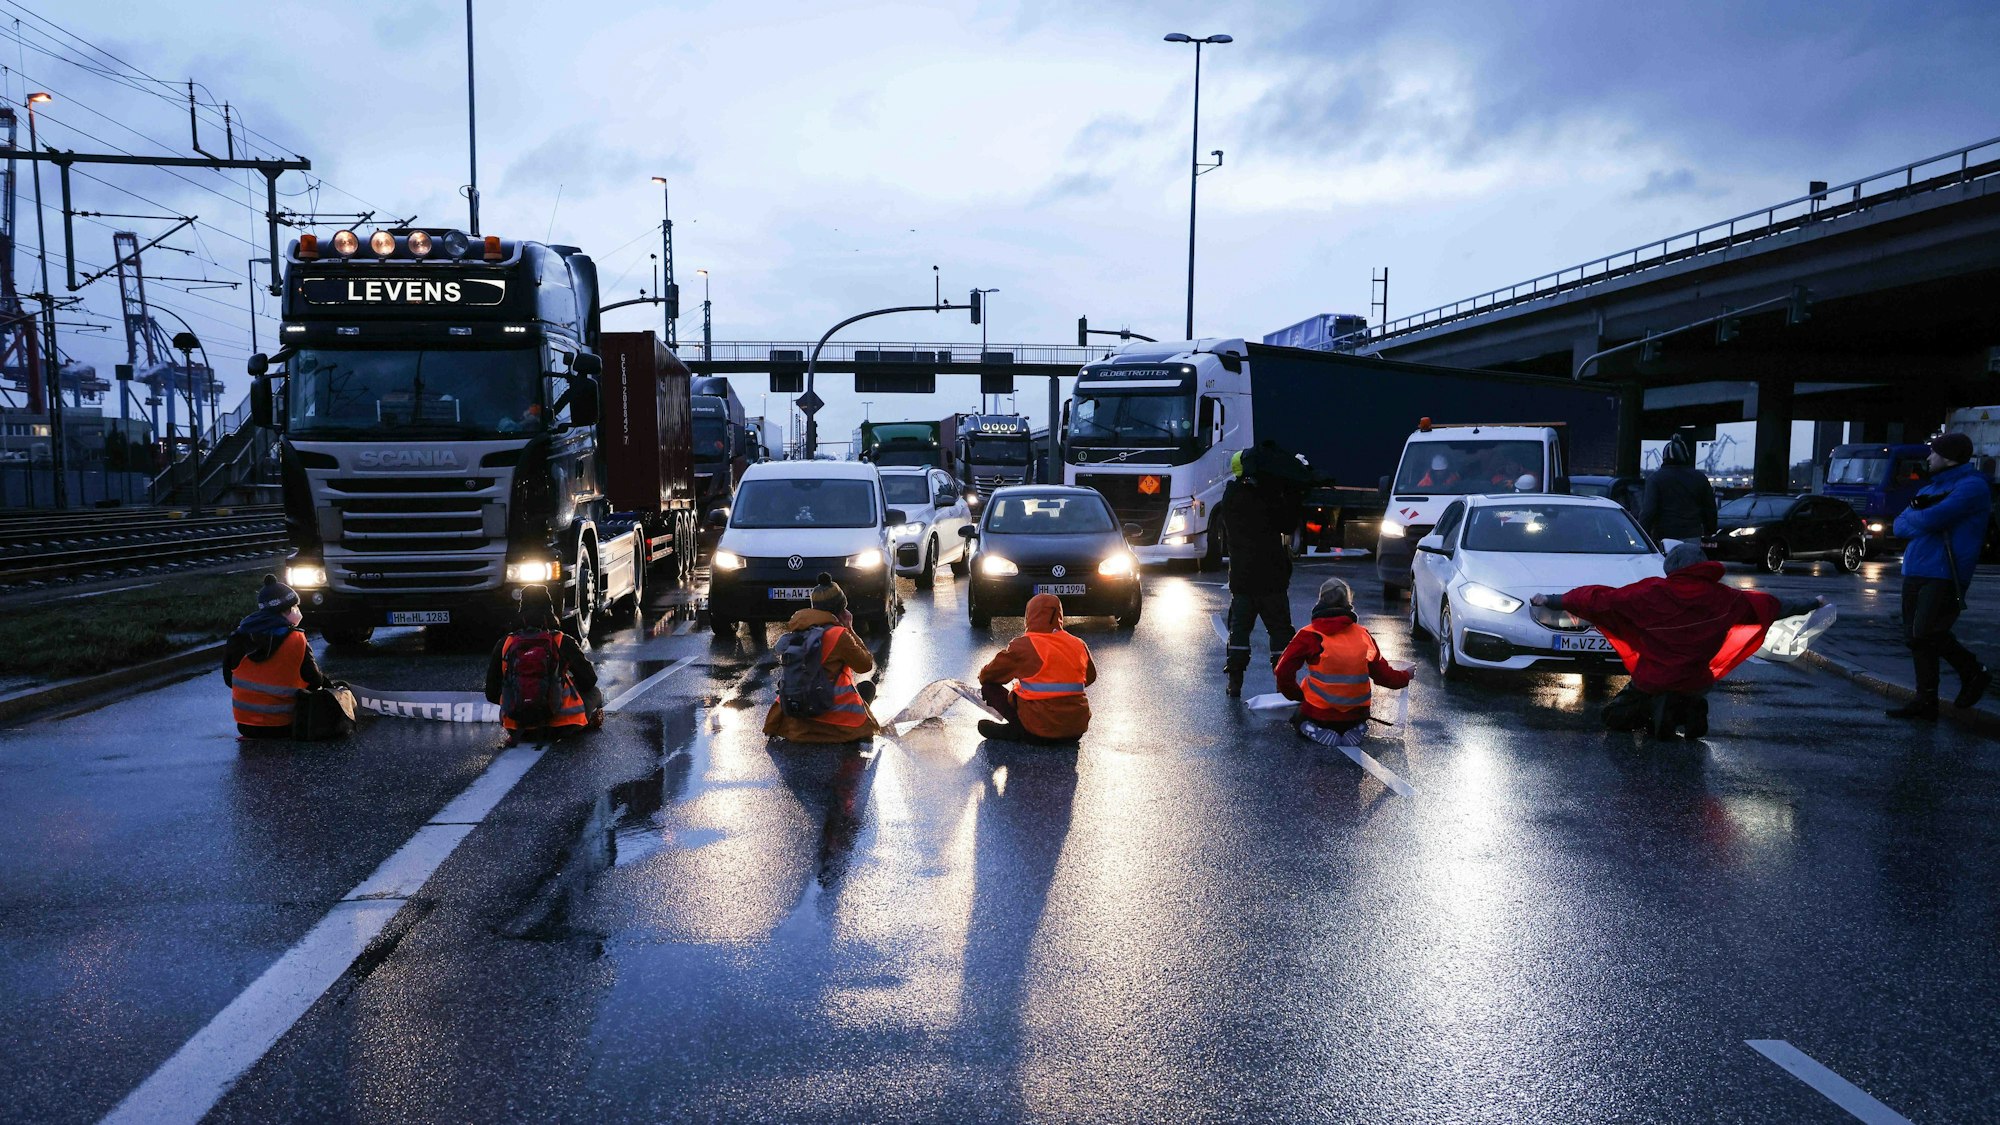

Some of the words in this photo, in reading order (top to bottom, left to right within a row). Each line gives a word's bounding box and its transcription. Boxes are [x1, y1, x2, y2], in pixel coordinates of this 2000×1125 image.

[348, 280, 462, 302] LEVENS
[1099, 369, 1169, 377] GLOBETROTTER
[359, 450, 459, 467] SCANIA
[773, 589, 786, 598] HH
[393, 613, 406, 623] HH
[412, 612, 424, 622] HL
[426, 612, 449, 622] 1283
[1562, 638, 1570, 649] M
[1579, 638, 1596, 649] VZ
